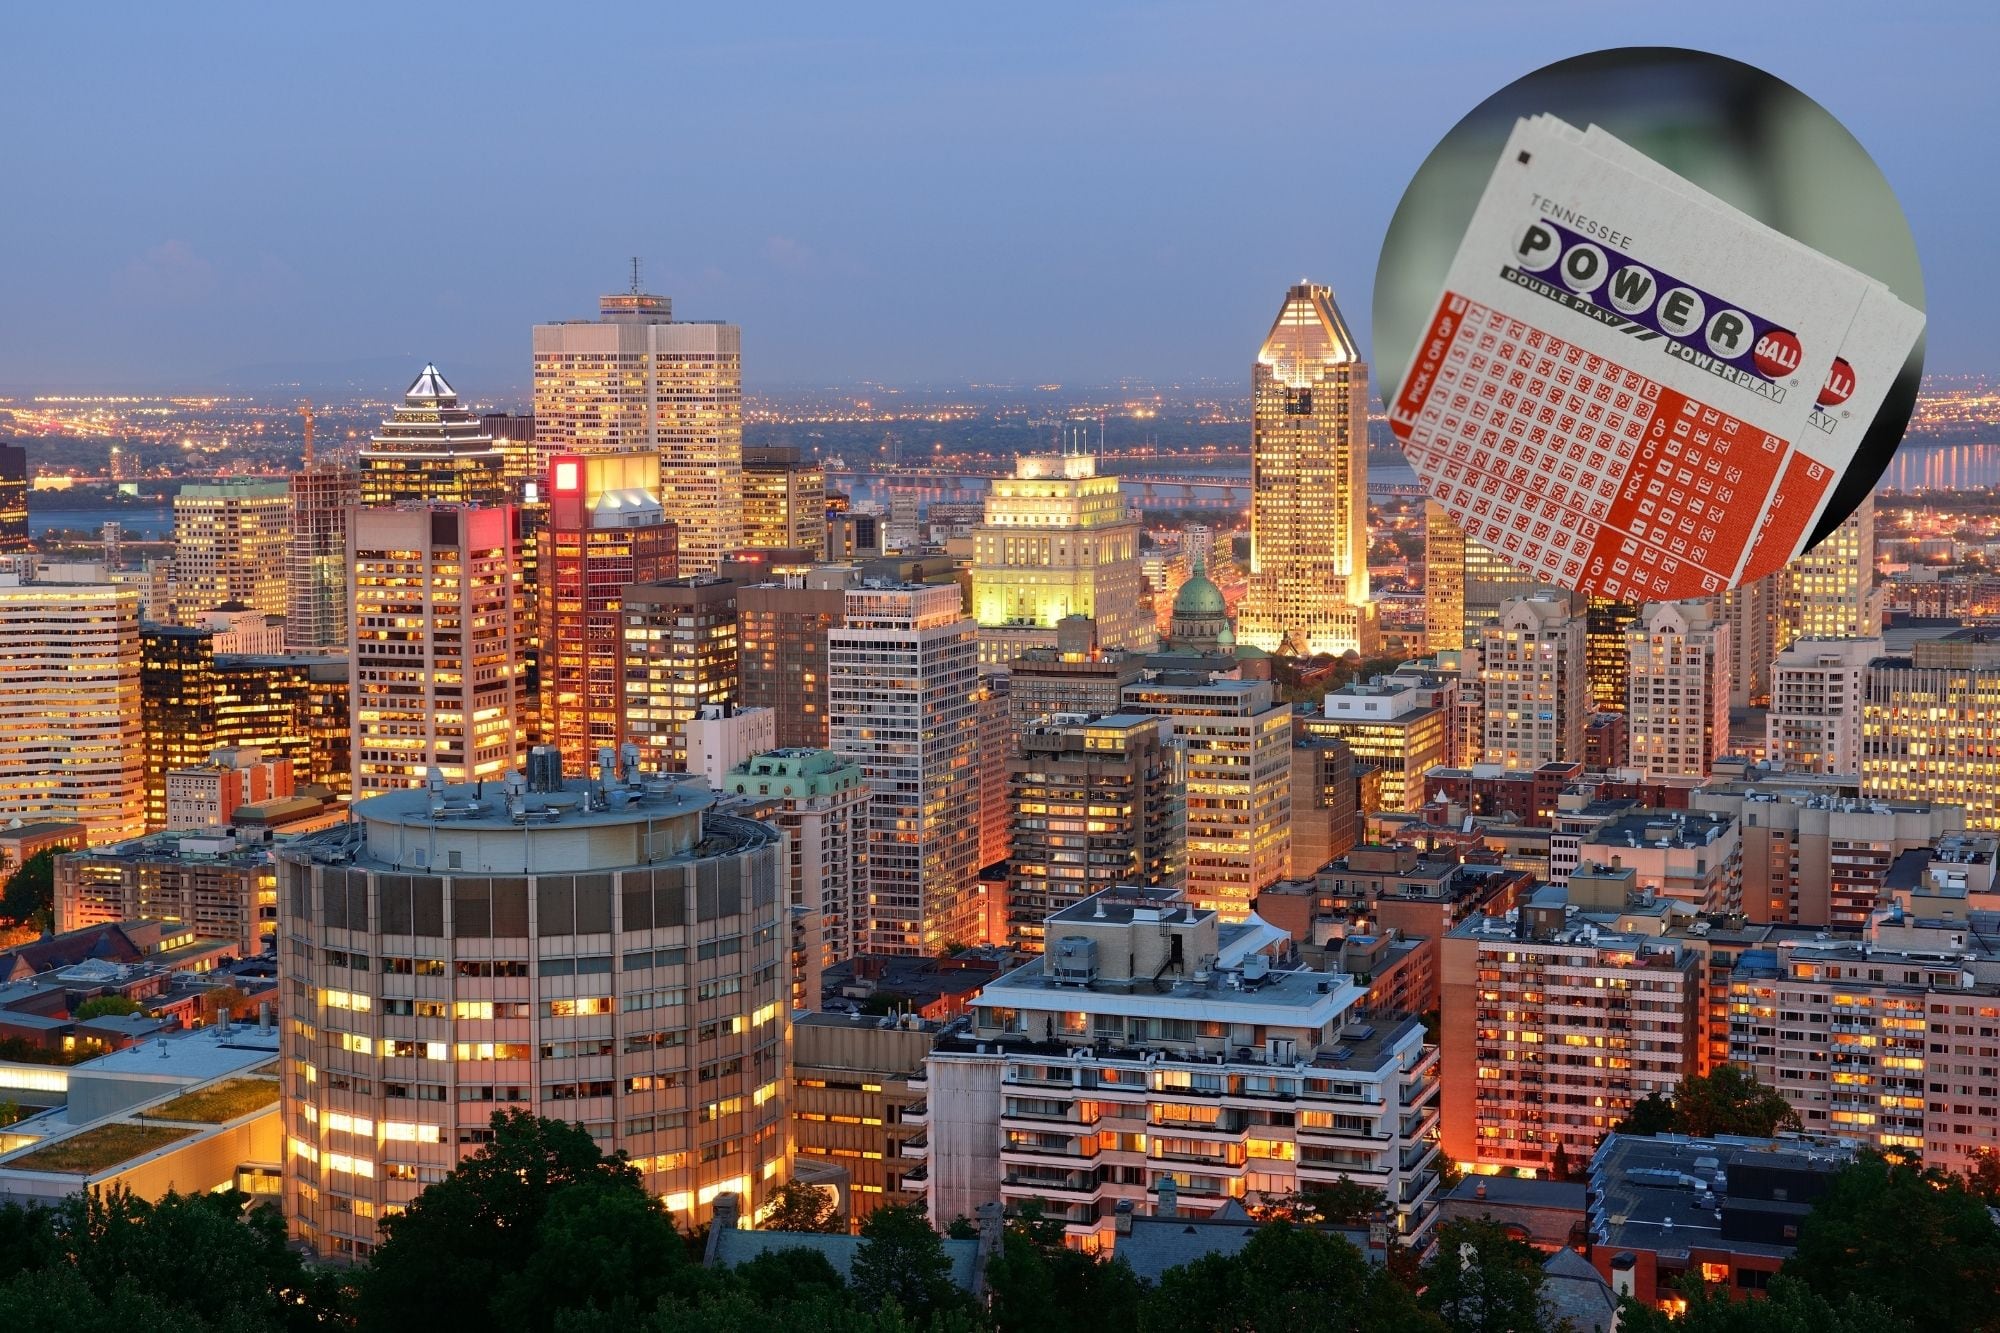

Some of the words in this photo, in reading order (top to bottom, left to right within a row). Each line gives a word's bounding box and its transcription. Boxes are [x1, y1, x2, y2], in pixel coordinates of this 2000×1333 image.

[1529, 193, 1633, 250] TENNESSEE
[1505, 269, 1569, 304] DOUBLE
[1573, 299, 1614, 324] PLAY
[1427, 338, 1444, 360] OR
[1437, 316, 1452, 337] QP
[1408, 372, 1430, 403] PICK
[1416, 429, 1428, 439] 1
[1425, 409, 1438, 420] 2
[1434, 389, 1447, 399] 3
[1443, 369, 1456, 379] 4
[1452, 348, 1465, 359] 5
[1461, 328, 1474, 339] 6
[1470, 307, 1483, 318] 7
[1422, 361, 1434, 371] 5
[1435, 437, 1448, 447] 8
[1444, 417, 1457, 427] 9
[1452, 394, 1467, 409] 10
[1462, 374, 1476, 389] 11
[1470, 354, 1485, 369] 12
[1480, 333, 1495, 349] 13
[1489, 314, 1504, 329] 14
[1453, 442, 1468, 458] 15
[1462, 422, 1477, 438] 16
[1472, 401, 1486, 417] 17
[1481, 383, 1496, 398] 18
[1490, 363, 1505, 378] 19
[1499, 342, 1514, 359] 20
[1508, 322, 1523, 339] 21
[1823, 370, 1853, 398] ALL
[1391, 405, 1418, 426] E
[1473, 449, 1488, 467] 22
[1482, 430, 1497, 447] 23
[1491, 410, 1506, 427] 24
[1500, 390, 1515, 407] 25
[1509, 370, 1524, 387] 26
[1518, 349, 1533, 367] 27
[1527, 330, 1542, 347] 28
[1492, 458, 1507, 475] 29
[1501, 438, 1516, 455] 30
[1510, 419, 1525, 435] 31
[1519, 399, 1534, 415] 32
[1528, 378, 1543, 395] 33
[1537, 359, 1552, 375] 34
[1546, 338, 1562, 355] 35
[1511, 467, 1527, 483] 36
[1521, 446, 1536, 463] 37
[1530, 426, 1545, 443] 38
[1539, 406, 1554, 423] 39
[1548, 387, 1563, 403] 40
[1557, 367, 1572, 383] 41
[1566, 347, 1581, 364] 42
[1532, 475, 1546, 492] 43
[1540, 455, 1555, 472] 44
[1550, 435, 1564, 452] 45
[1559, 415, 1574, 432] 46
[1568, 395, 1582, 412] 47
[1577, 375, 1591, 392] 48
[1586, 355, 1600, 372] 49
[1406, 449, 1419, 460] 7
[1550, 483, 1566, 501] 50
[1560, 464, 1575, 481] 51
[1569, 443, 1584, 461] 52
[1578, 424, 1593, 441] 53
[1587, 403, 1602, 420] 54
[1596, 383, 1611, 401] 55
[1605, 364, 1620, 381] 56
[1570, 492, 1585, 509] 57
[1579, 472, 1594, 489] 58
[1588, 452, 1603, 469] 59
[1597, 432, 1612, 449] 60
[1606, 413, 1621, 429] 61
[1615, 393, 1631, 409] 62
[1624, 373, 1639, 390] 63
[1590, 501, 1605, 518] 64
[1599, 481, 1614, 498] 65
[1608, 461, 1623, 478] 66
[1617, 441, 1632, 458] 67
[1626, 421, 1641, 438] 68
[1635, 402, 1650, 418] 69
[1646, 383, 1659, 398] QP
[1622, 470, 1644, 501] PICK
[1642, 439, 1658, 459] OR
[1651, 417, 1666, 437] QP
[1764, 436, 1777, 451] QP
[1425, 453, 1441, 470] 14
[1435, 482, 1450, 499] 20
[1444, 462, 1459, 478] 21
[1454, 489, 1469, 507] 27
[1464, 470, 1479, 486] 28
[1632, 522, 1644, 531] 1
[1640, 502, 1653, 513] 2
[1649, 482, 1662, 493] 3
[1658, 462, 1671, 472] 4
[1667, 442, 1679, 453] 5
[1676, 422, 1688, 433] 6
[1684, 402, 1697, 413] 7
[1652, 530, 1664, 541] 8
[1660, 511, 1673, 521] 9
[1668, 487, 1683, 504] 10
[1677, 468, 1692, 484] 11
[1686, 448, 1701, 464] 12
[1695, 428, 1710, 444] 13
[1703, 408, 1718, 424] 14
[1670, 536, 1685, 552] 15
[1679, 516, 1695, 532] 16
[1688, 496, 1704, 513] 17
[1697, 477, 1712, 493] 18
[1706, 456, 1720, 473] 19
[1714, 437, 1729, 454] 20
[1723, 417, 1738, 434] 21
[1808, 464, 1822, 479] QP
[1465, 517, 1480, 534] 33
[1474, 498, 1489, 514] 34
[1483, 477, 1499, 494] 35
[1485, 526, 1500, 542] 40
[1494, 506, 1509, 522] 41
[1503, 485, 1519, 502] 42
[1505, 533, 1519, 550] 47
[1514, 514, 1529, 530] 48
[1523, 493, 1538, 511] 49
[1524, 542, 1540, 559] 54
[1533, 522, 1549, 539] 55
[1542, 503, 1557, 520] 56
[1690, 545, 1706, 562] 22
[1699, 525, 1715, 542] 23
[1708, 506, 1723, 522] 24
[1717, 485, 1732, 503] 25
[1725, 465, 1741, 483] 26
[1544, 551, 1559, 567] 61
[1553, 531, 1568, 547] 62
[1562, 511, 1577, 528] 63
[1564, 560, 1579, 577] 68
[1573, 540, 1588, 556] 69
[1584, 522, 1596, 536] QP
[1590, 555, 1604, 576] QP
[1605, 581, 1618, 591] 5
[1614, 561, 1627, 571] 6
[1623, 541, 1635, 551] 7
[1633, 566, 1648, 583] 13
[1641, 547, 1657, 563] 14
[1653, 575, 1669, 593] 20
[1662, 556, 1677, 573] 21
[1704, 576, 1716, 590] QP
